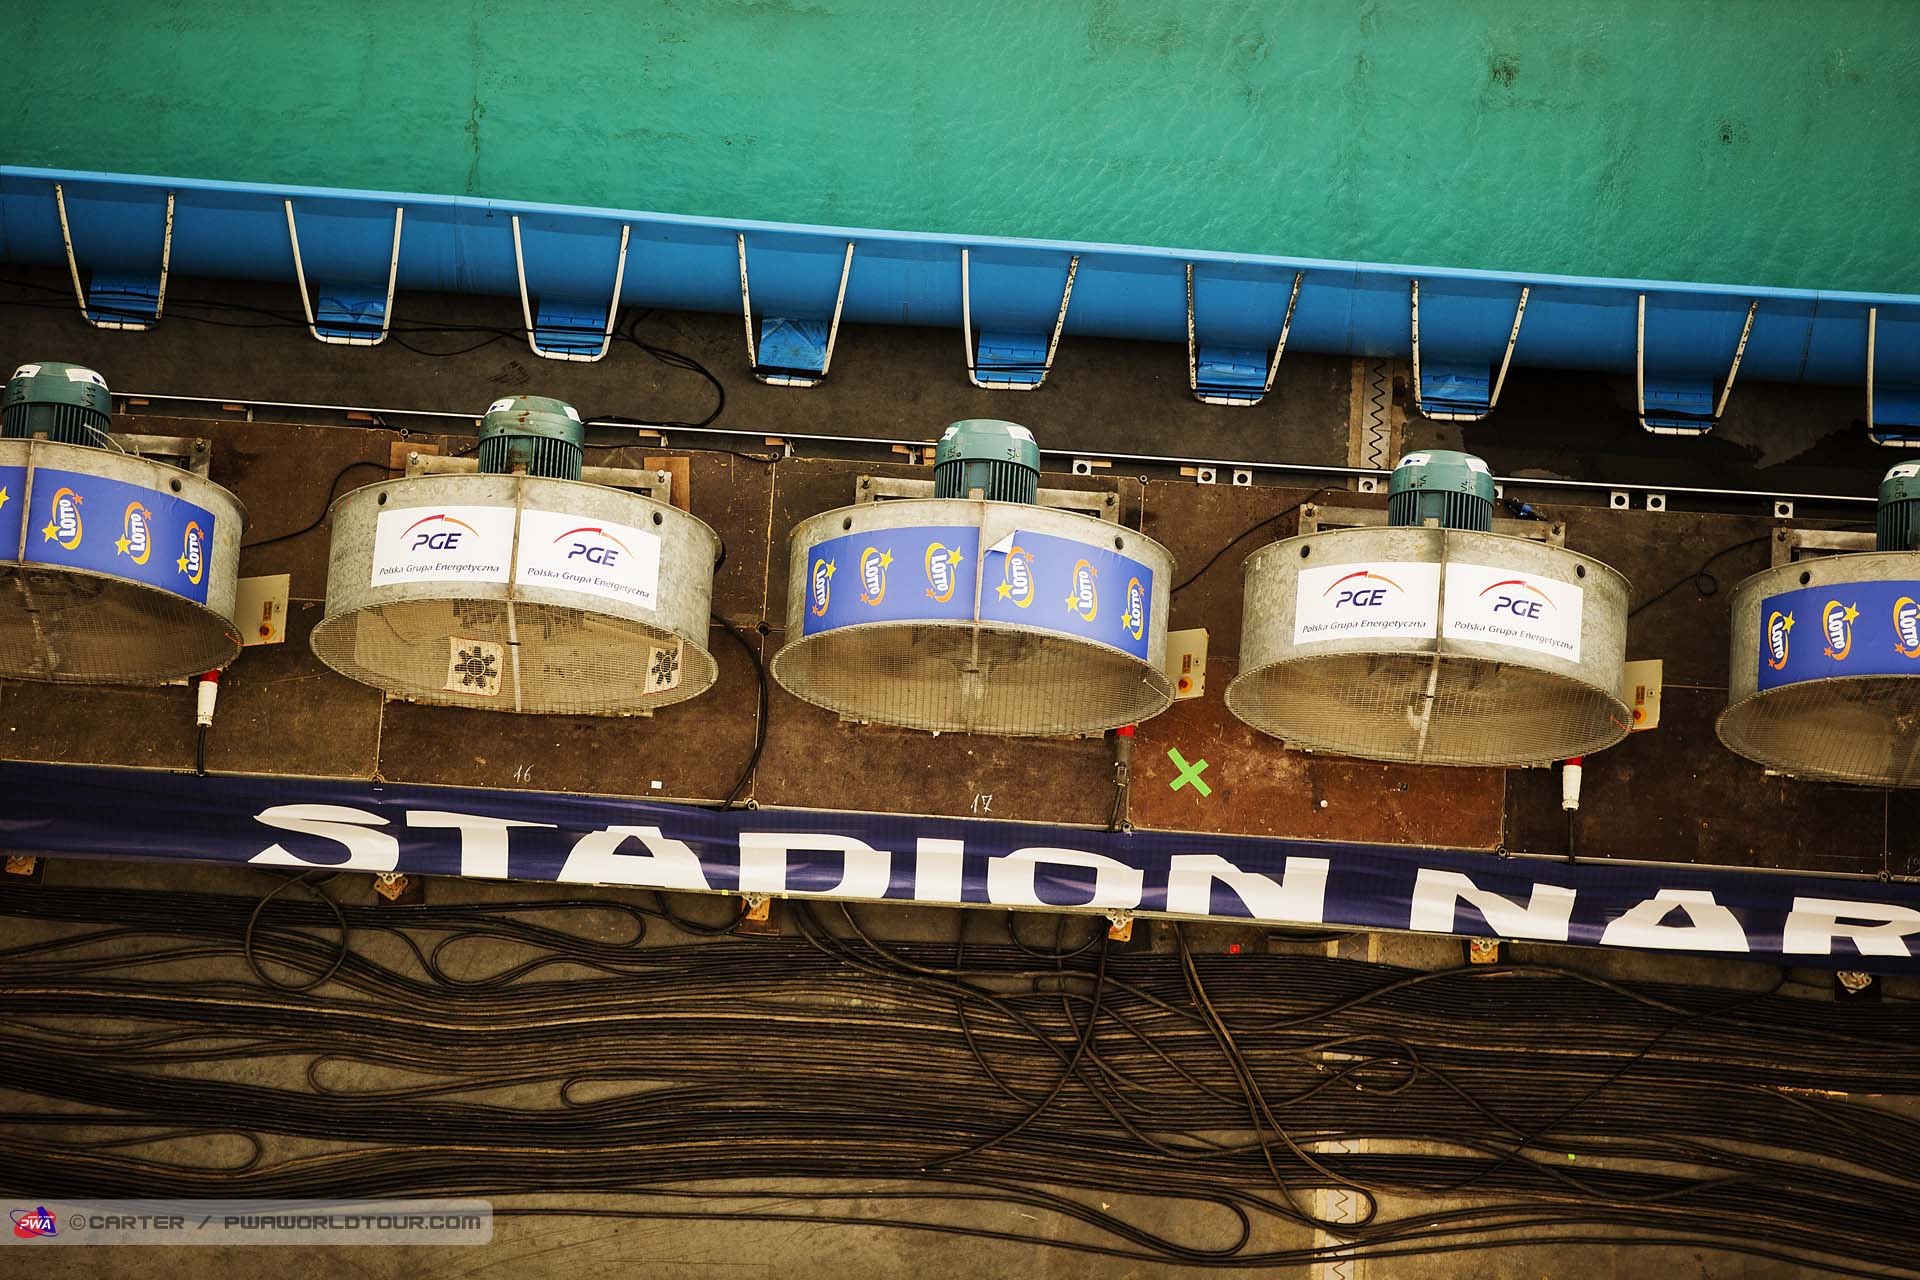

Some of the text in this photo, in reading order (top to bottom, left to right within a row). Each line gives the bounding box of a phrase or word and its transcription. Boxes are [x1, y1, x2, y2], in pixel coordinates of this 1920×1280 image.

[59, 499, 76, 537] LOTTO
[130, 513, 146, 551] LOTTO
[188, 533, 199, 571] LOTTO
[412, 533, 462, 551] PGE
[568, 543, 619, 567] PGE
[379, 562, 500, 576] Polska Grupa Energetyczna
[527, 567, 650, 599] Polska Grupa Energetyczna
[815, 568, 826, 606] LOTTO
[865, 557, 880, 595] LOTTO
[931, 554, 949, 591] LOTTO
[1011, 558, 1028, 595] LOTTO
[1078, 570, 1093, 608] LOTTO
[1336, 589, 1387, 608] PGE
[1493, 596, 1543, 619] PGE
[1131, 589, 1141, 627] LOTTO
[1302, 619, 1427, 633] Polska Grupa Energetyczna
[1454, 620, 1574, 651] Polska Grupa Energetyczna
[1772, 621, 1785, 659] LOTTO
[1828, 611, 1845, 649] LOTTO
[1900, 608, 1919, 647] LOTTO
[513, 764, 535, 783] 16
[248, 803, 1920, 957] STADION NAR
